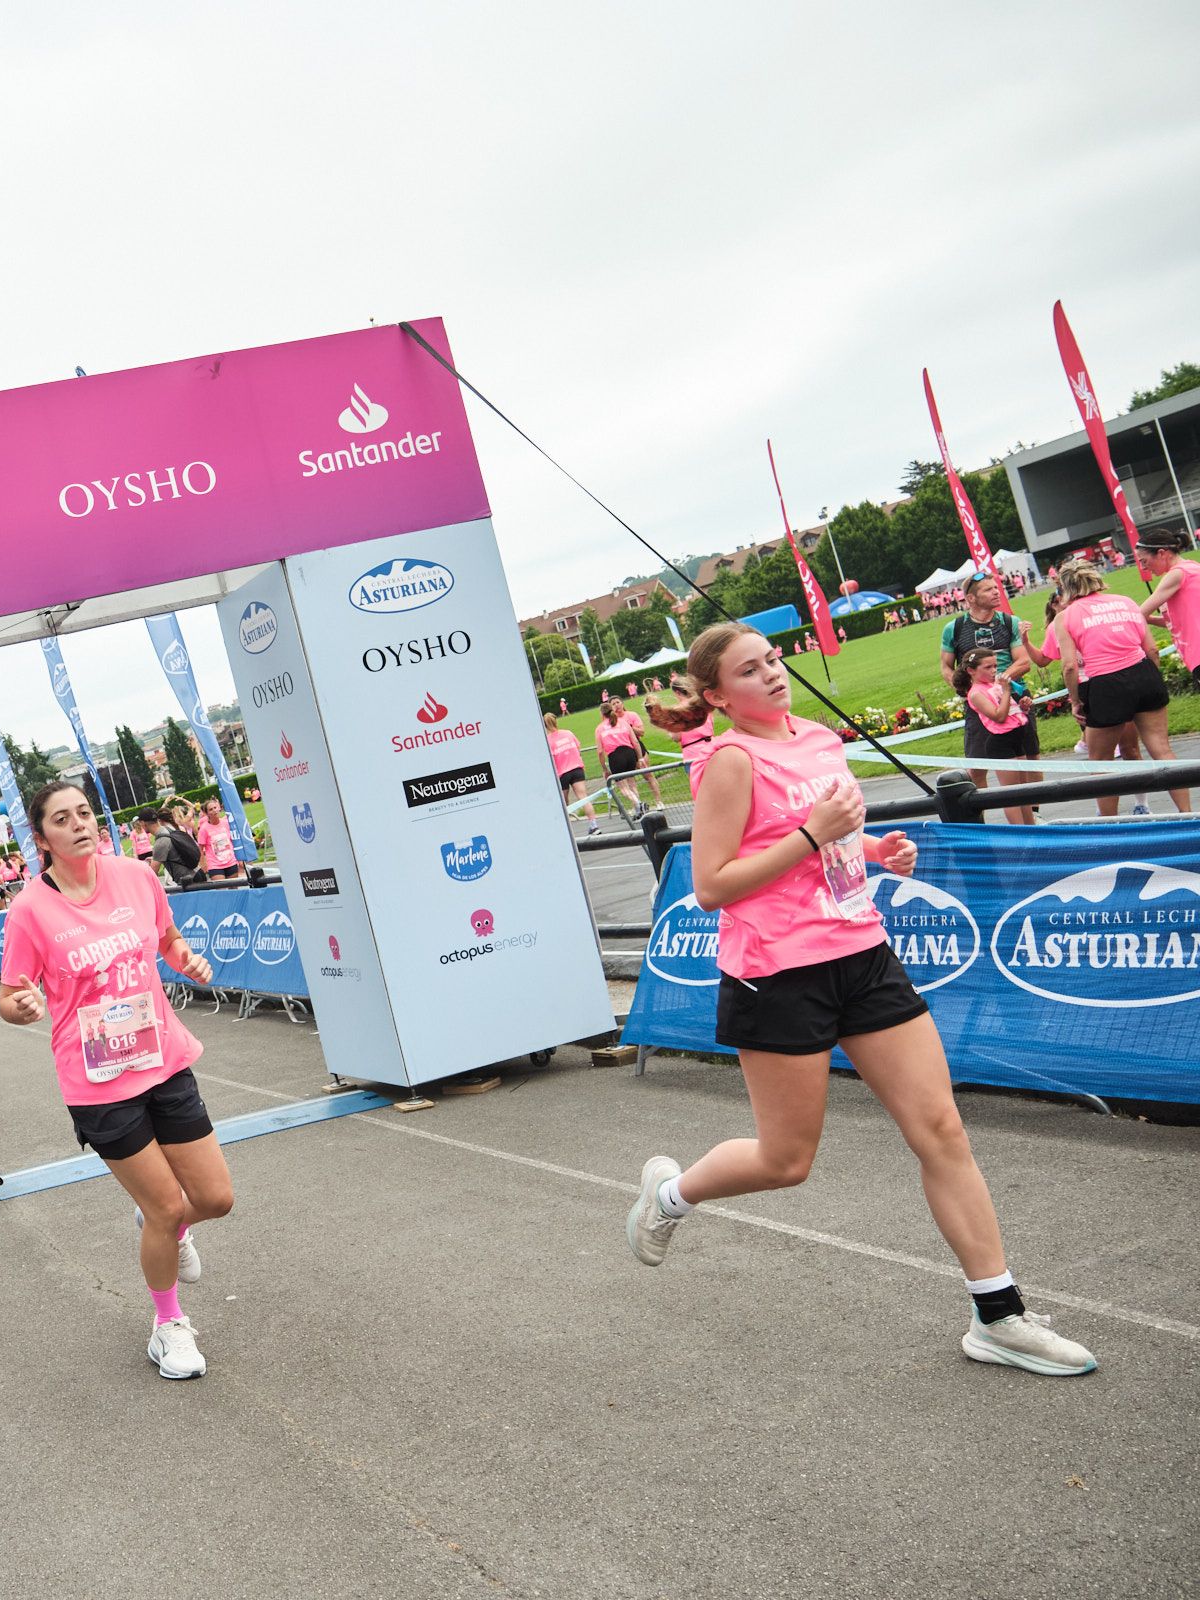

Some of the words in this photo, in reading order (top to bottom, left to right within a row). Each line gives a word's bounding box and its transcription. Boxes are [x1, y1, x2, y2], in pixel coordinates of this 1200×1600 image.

[299, 430, 442, 477] Santander
[58, 461, 217, 518] OYSHO
[359, 576, 448, 606] ASTURIANA
[242, 618, 275, 647] ASTURIANA
[362, 630, 471, 672] OYSHO
[252, 671, 293, 708] OYSHO
[392, 719, 481, 753] Santander
[274, 760, 310, 783] Santander
[409, 772, 488, 800] Neutrogena
[446, 848, 489, 872] Marlene
[846, 855, 864, 876] 01
[303, 876, 335, 893] Neutrogena
[894, 914, 957, 927] LECHERA
[1049, 910, 1134, 925] CENTRAL
[1144, 909, 1196, 924] LECH
[55, 925, 87, 942] OYSHO
[255, 930, 291, 951] ASTURIANA
[650, 920, 719, 958] ASTUR
[439, 943, 494, 965] octopus
[494, 931, 538, 951] energy
[109, 1032, 138, 1050] 016
